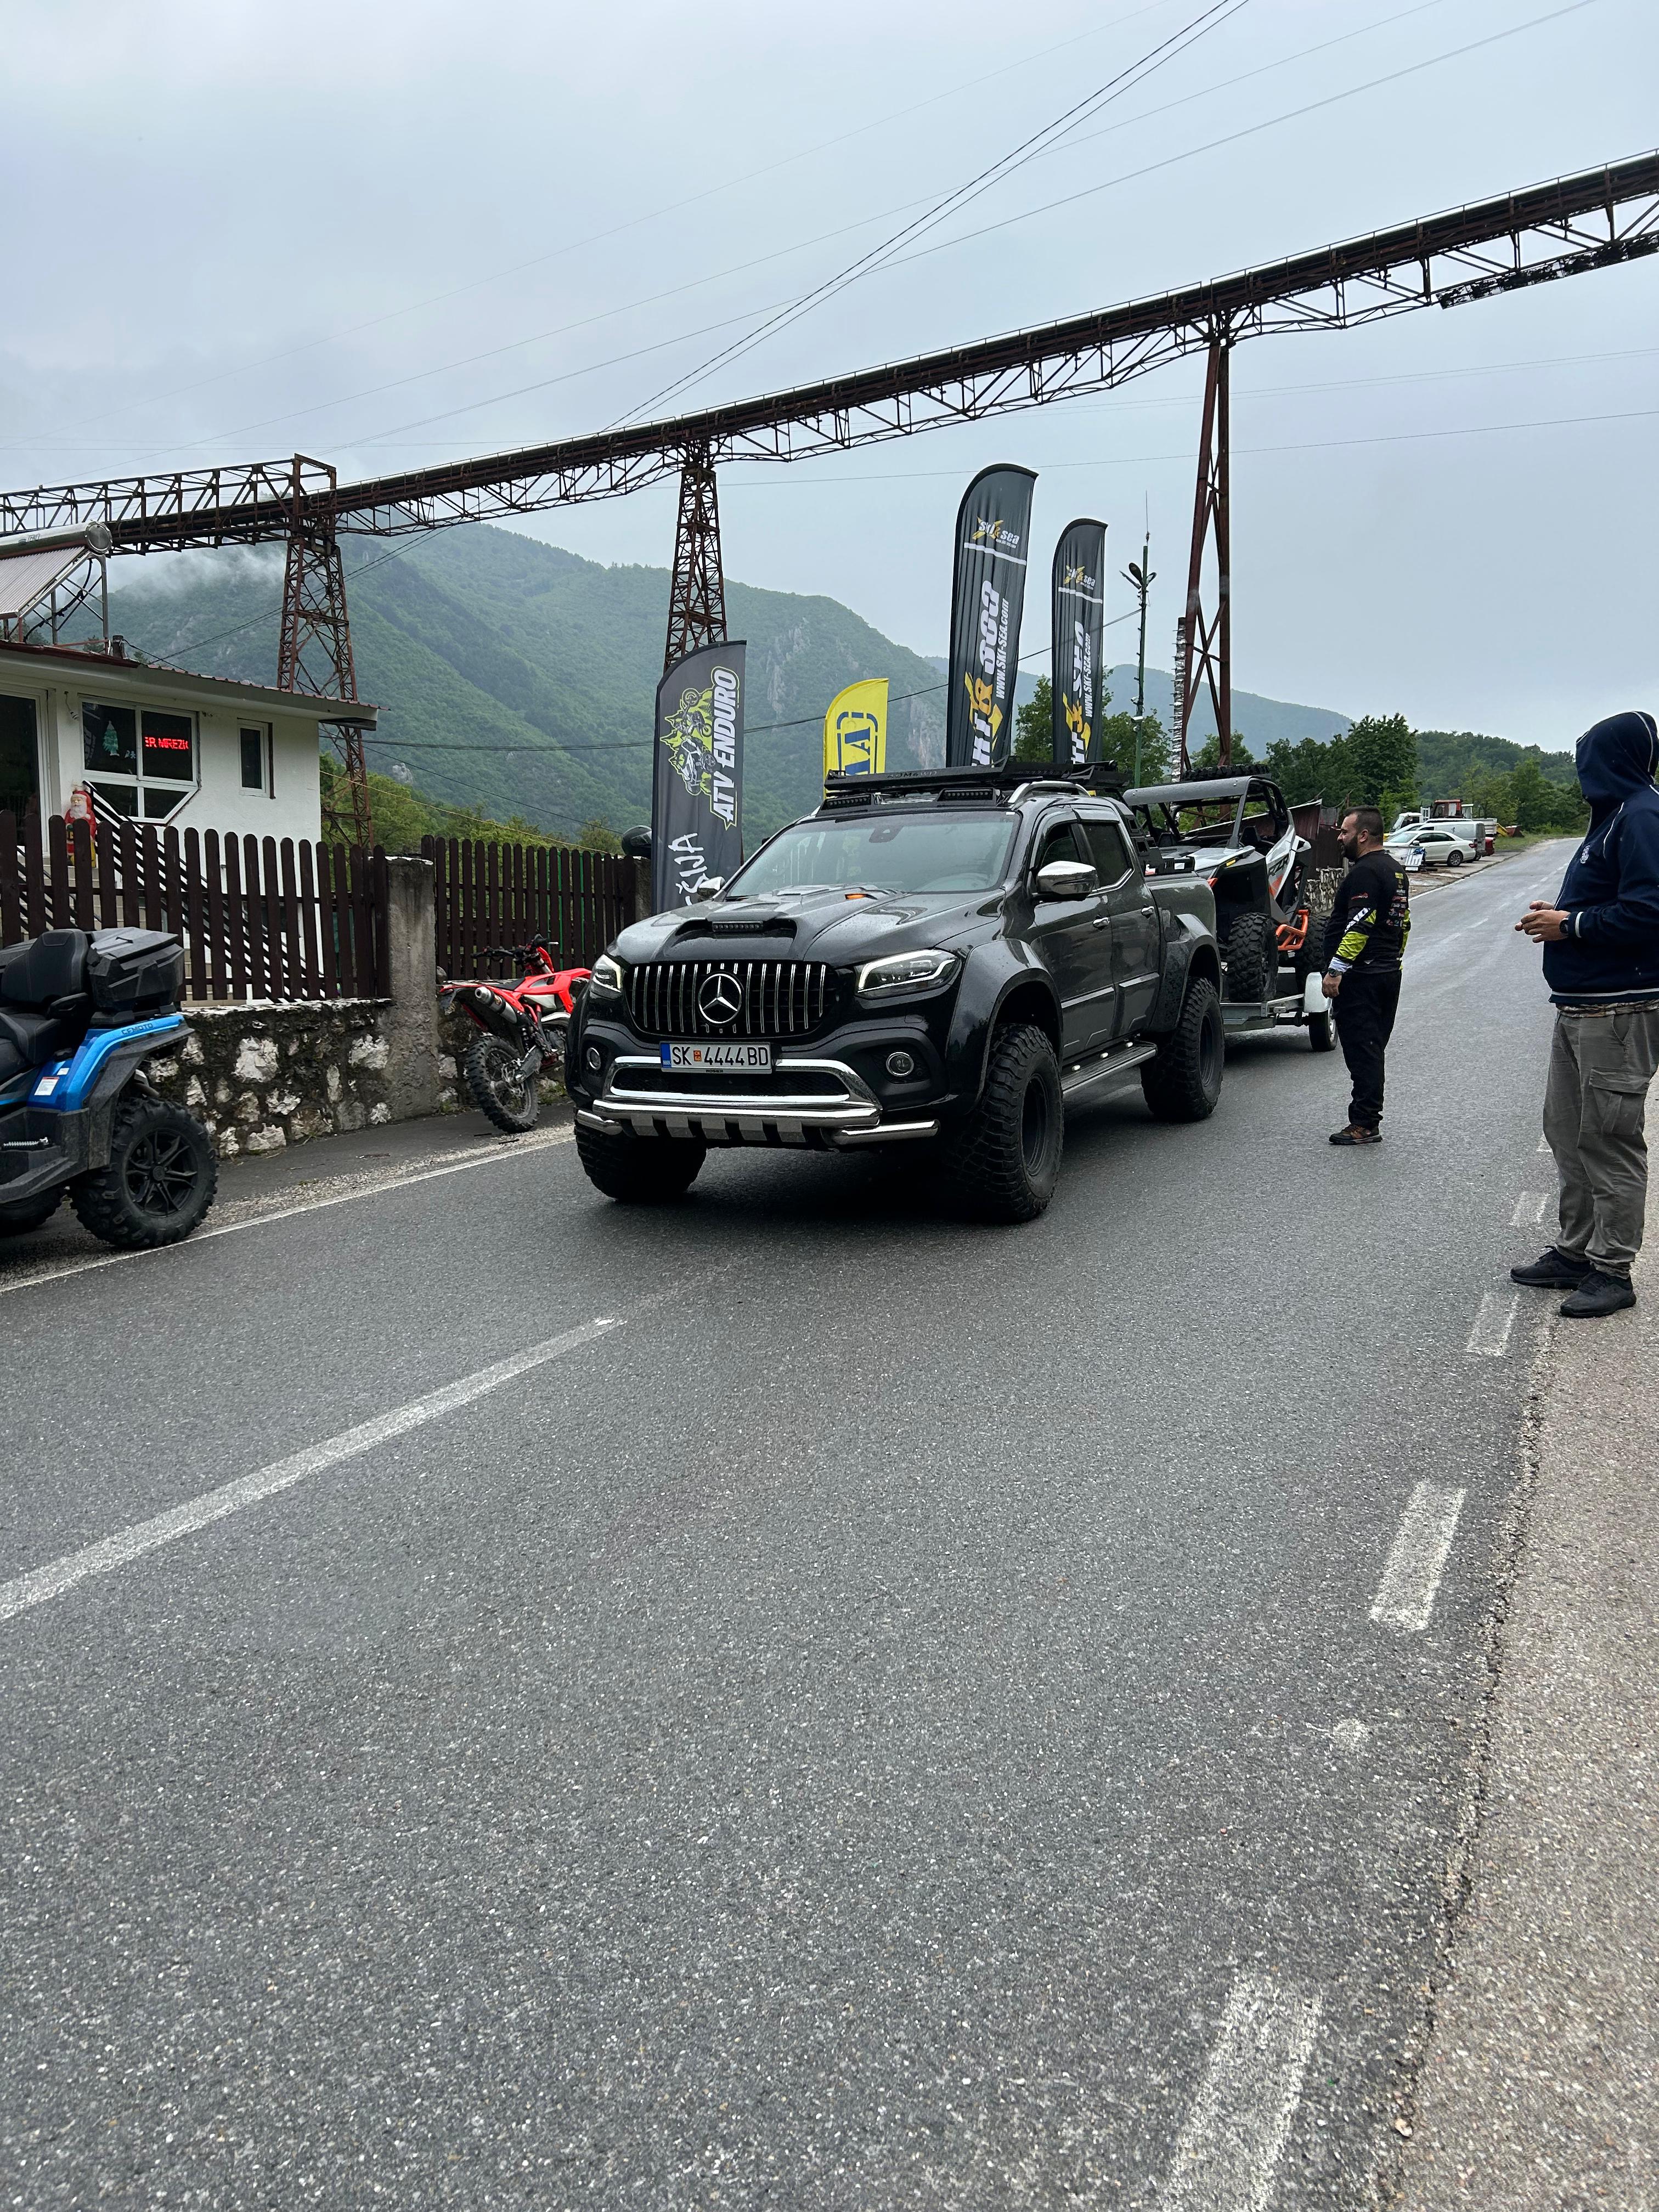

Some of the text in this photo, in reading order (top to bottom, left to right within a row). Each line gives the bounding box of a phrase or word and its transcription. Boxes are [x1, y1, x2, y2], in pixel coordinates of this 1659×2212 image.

[714, 669, 737, 822] ATV ENDURO
[121, 1023, 154, 1035] CFMOTO
[672, 1046, 692, 1065] SK
